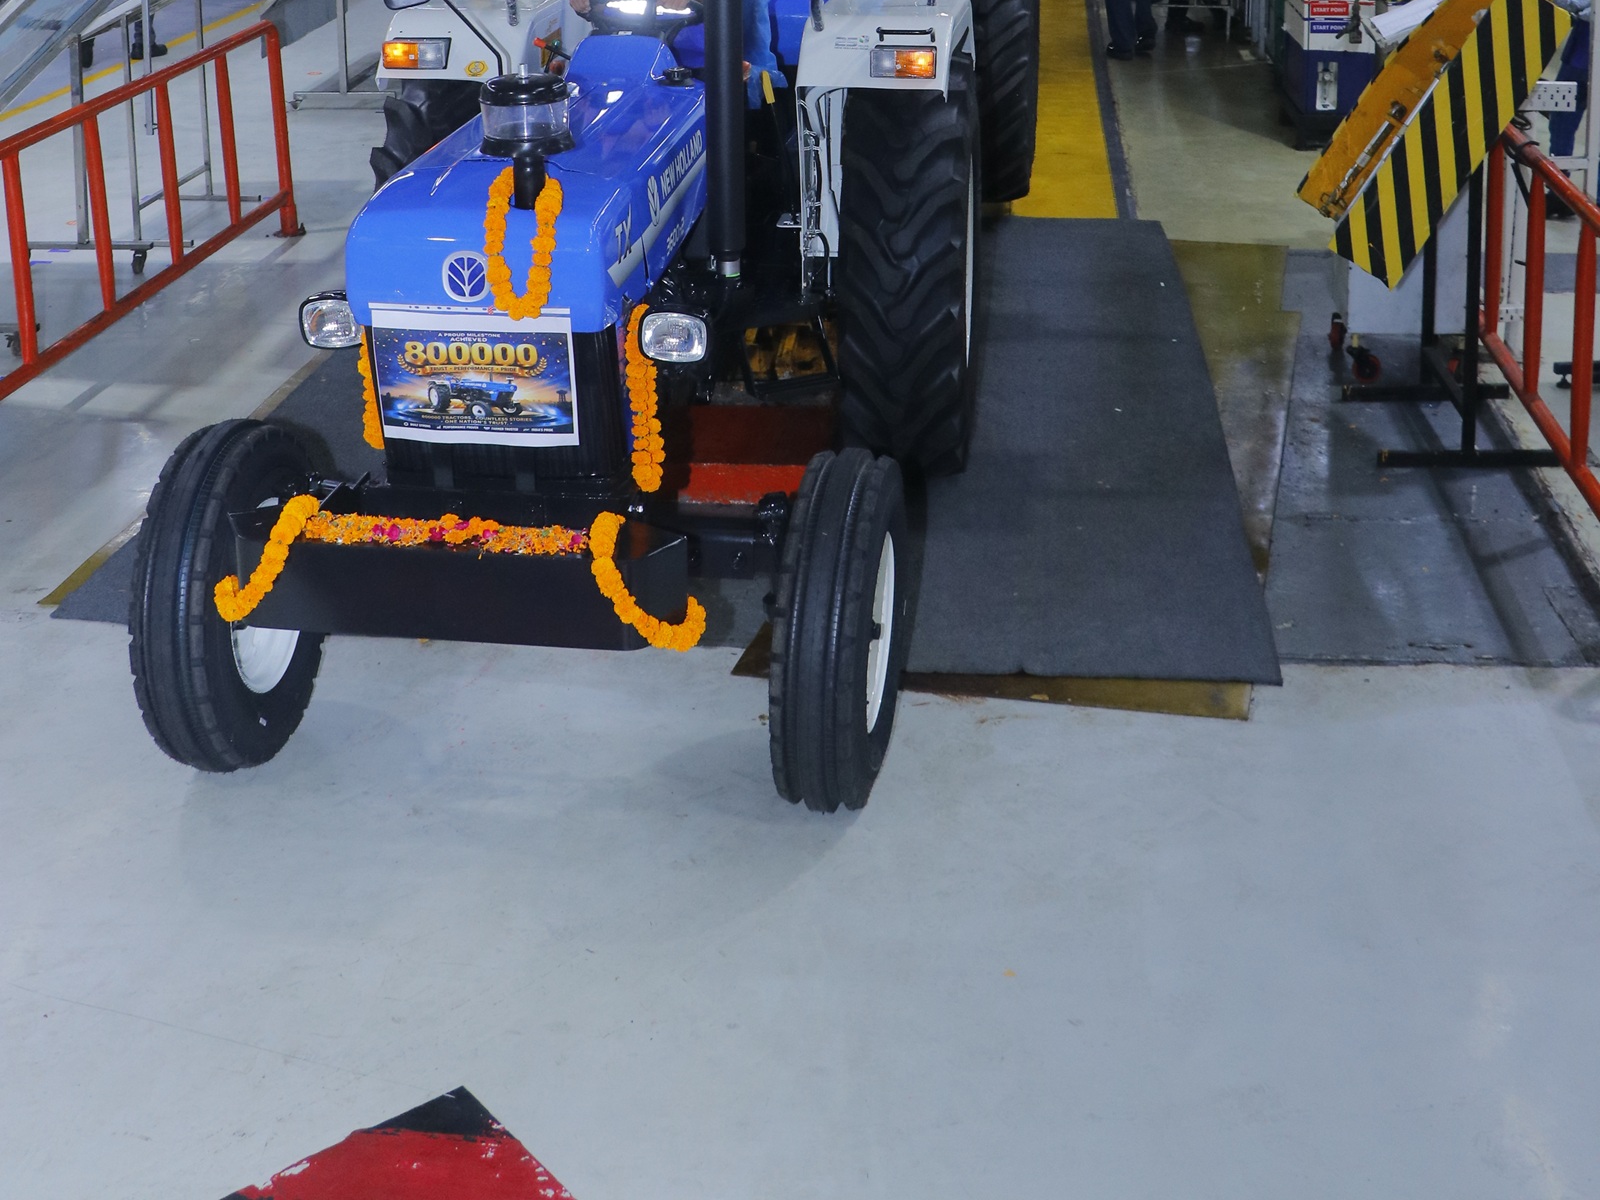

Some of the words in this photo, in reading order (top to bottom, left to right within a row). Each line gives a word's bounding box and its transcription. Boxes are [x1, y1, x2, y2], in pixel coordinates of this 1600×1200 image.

[660, 161, 676, 200] NEW
[674, 129, 703, 182] HOLLAND
[615, 202, 632, 265] TX
[404, 341, 538, 366] 800000
